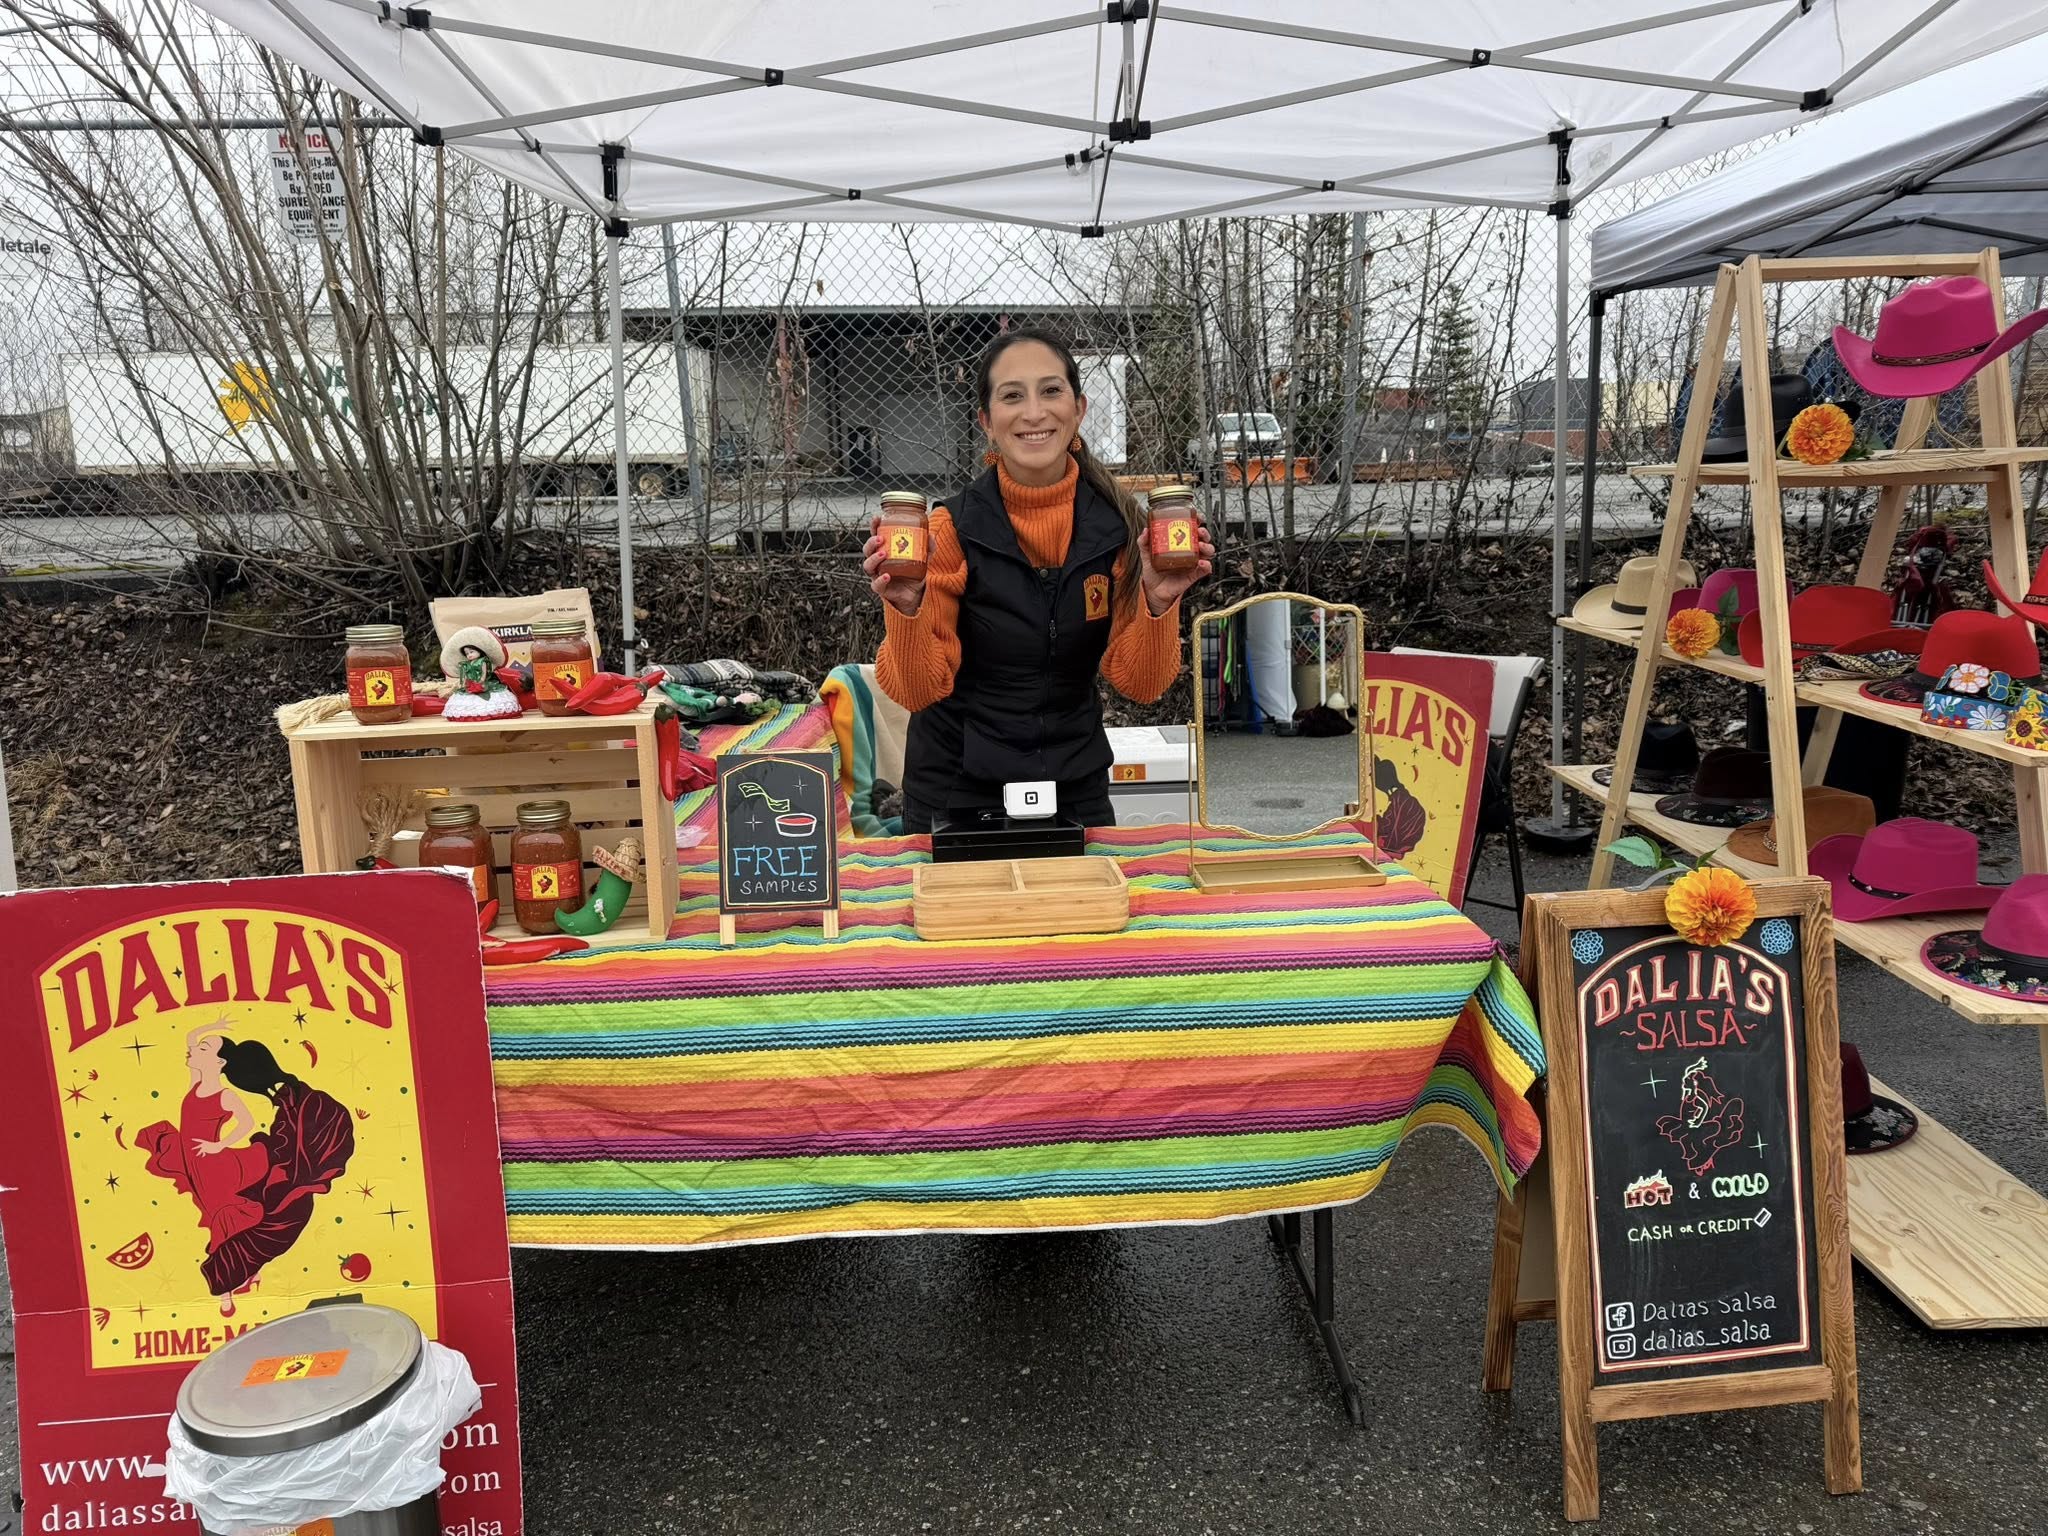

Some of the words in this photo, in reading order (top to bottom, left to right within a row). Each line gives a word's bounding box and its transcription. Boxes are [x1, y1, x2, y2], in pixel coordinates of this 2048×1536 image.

[272, 157, 290, 168] This
[324, 157, 338, 168] Ma
[282, 170, 293, 181] Be
[278, 196, 346, 208] SURVEANCE
[289, 184, 301, 196] By
[313, 183, 332, 194] DEO
[732, 845, 818, 877] FREE
[740, 879, 818, 895] SAMPLES
[55, 918, 393, 1054] DALIA'S
[1594, 950, 1775, 1027] DALIA'S
[1636, 1007, 1748, 1051] SALSA
[1624, 1184, 1674, 1209] HOT
[1688, 1181, 1701, 1200] &
[1711, 1172, 1770, 1199] MILD
[1627, 1225, 1673, 1242] CASH
[1697, 1217, 1754, 1236] CREDIT
[1643, 1301, 1710, 1323] Dalias
[1642, 1319, 1772, 1352] dalias_salsa
